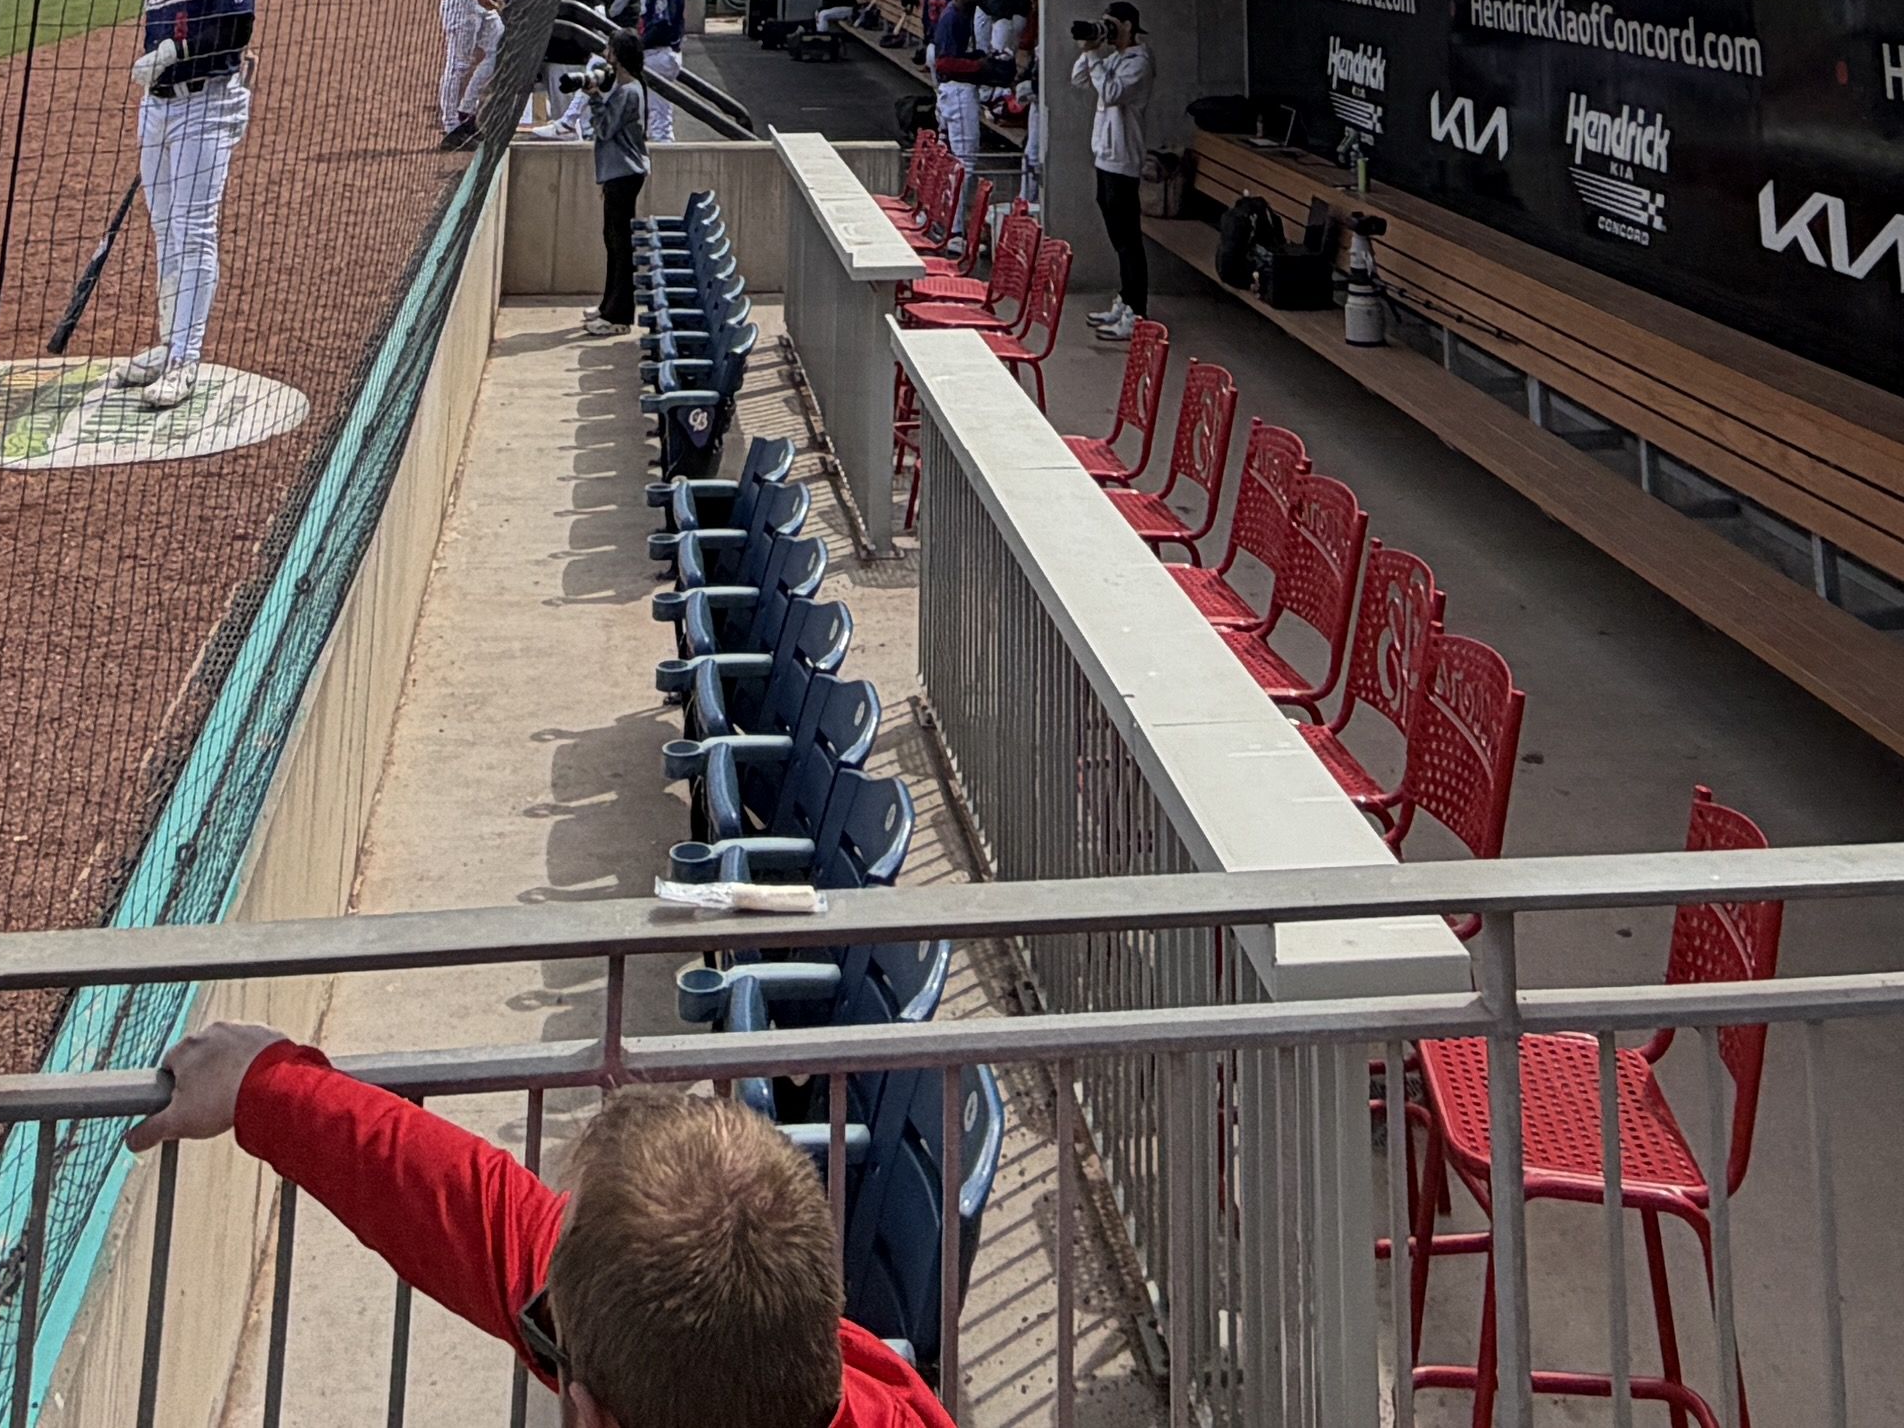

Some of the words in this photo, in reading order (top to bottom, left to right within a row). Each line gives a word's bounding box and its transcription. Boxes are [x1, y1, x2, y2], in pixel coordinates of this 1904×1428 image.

[1327, 35, 1387, 93] Hendrick
[1565, 91, 1670, 175] Hendrick
[1609, 161, 1635, 183] KIA
[1597, 215, 1651, 247] CONCORD
